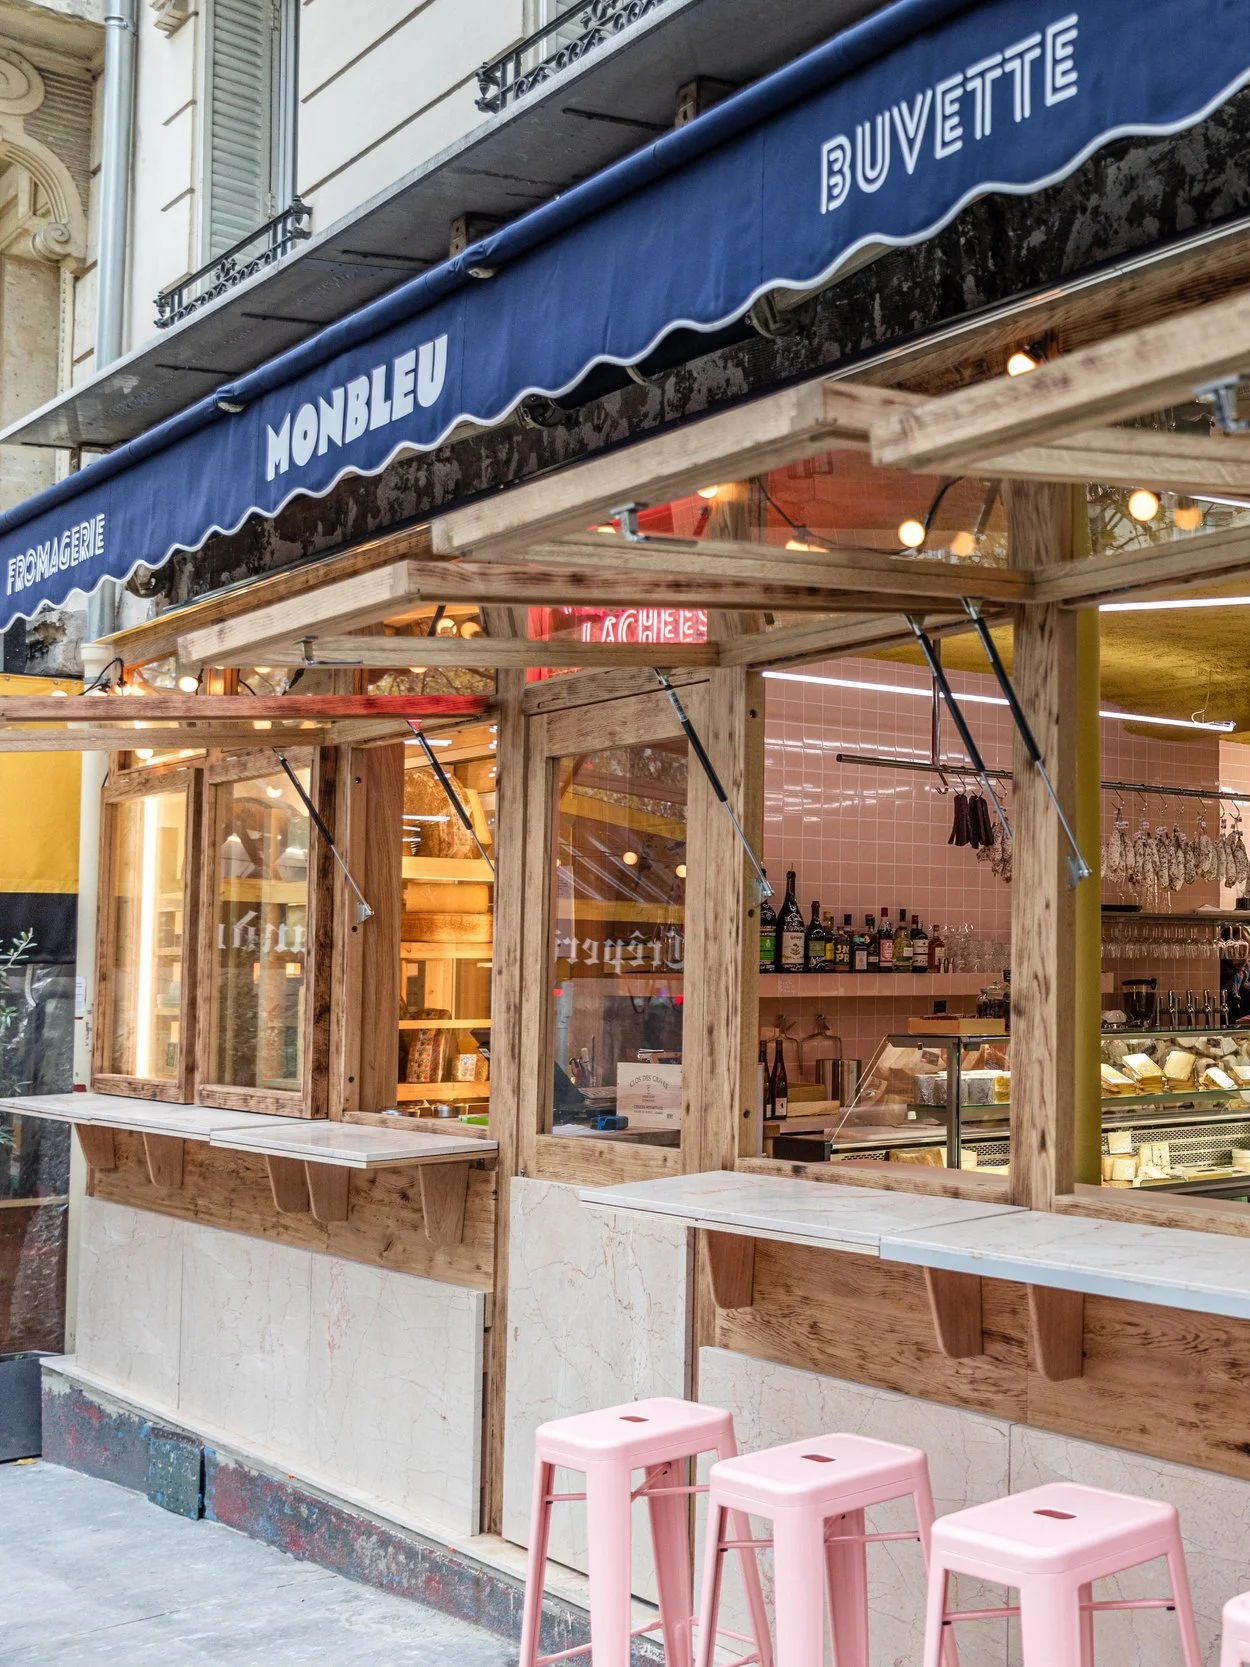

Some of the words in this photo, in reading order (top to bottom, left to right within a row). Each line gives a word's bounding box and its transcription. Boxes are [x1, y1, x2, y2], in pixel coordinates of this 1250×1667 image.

[820, 12, 1079, 215] BUVETTE
[265, 334, 449, 482] MONBLEU
[6, 513, 105, 596] FROMAGERIE
